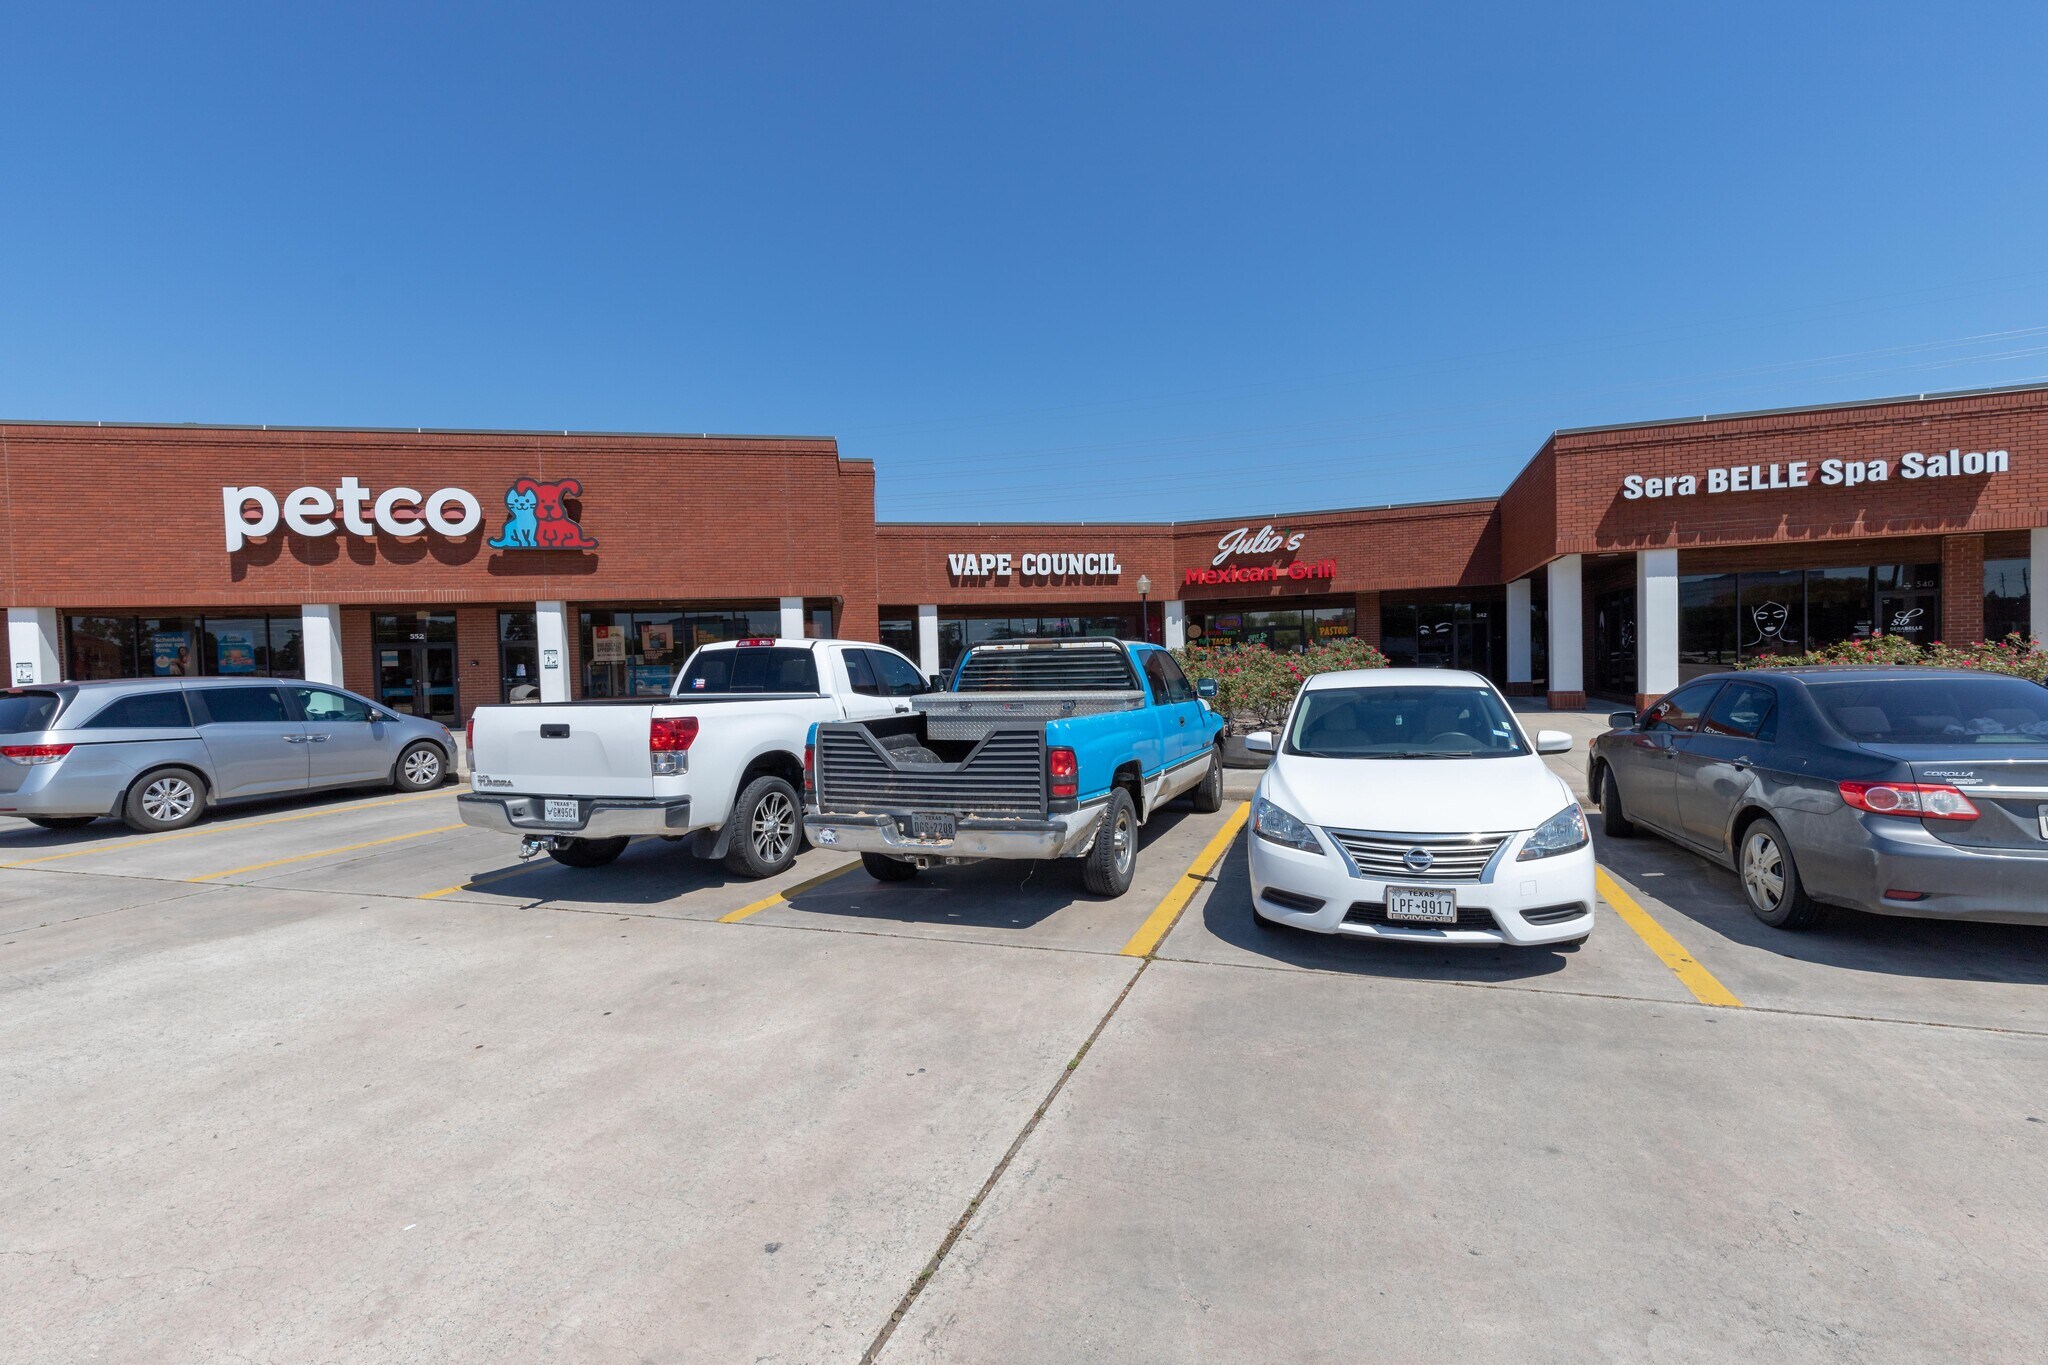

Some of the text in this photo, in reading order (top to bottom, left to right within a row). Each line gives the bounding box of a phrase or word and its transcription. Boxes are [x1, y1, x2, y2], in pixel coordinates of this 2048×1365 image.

[1623, 448, 2009, 500] Sera BELLE Spa Salon
[222, 476, 482, 553] petco
[1212, 525, 1305, 566] Julio's
[948, 553, 1122, 576] VAPE COUNCIL
[1185, 558, 1337, 585] Mexican Grill
[1915, 580, 1934, 588] 540
[1319, 625, 1349, 636] PASTOR
[1211, 637, 1232, 645] TACOS
[477, 779, 514, 788] TUNDRA
[1392, 914, 1453, 922] EMMONS
